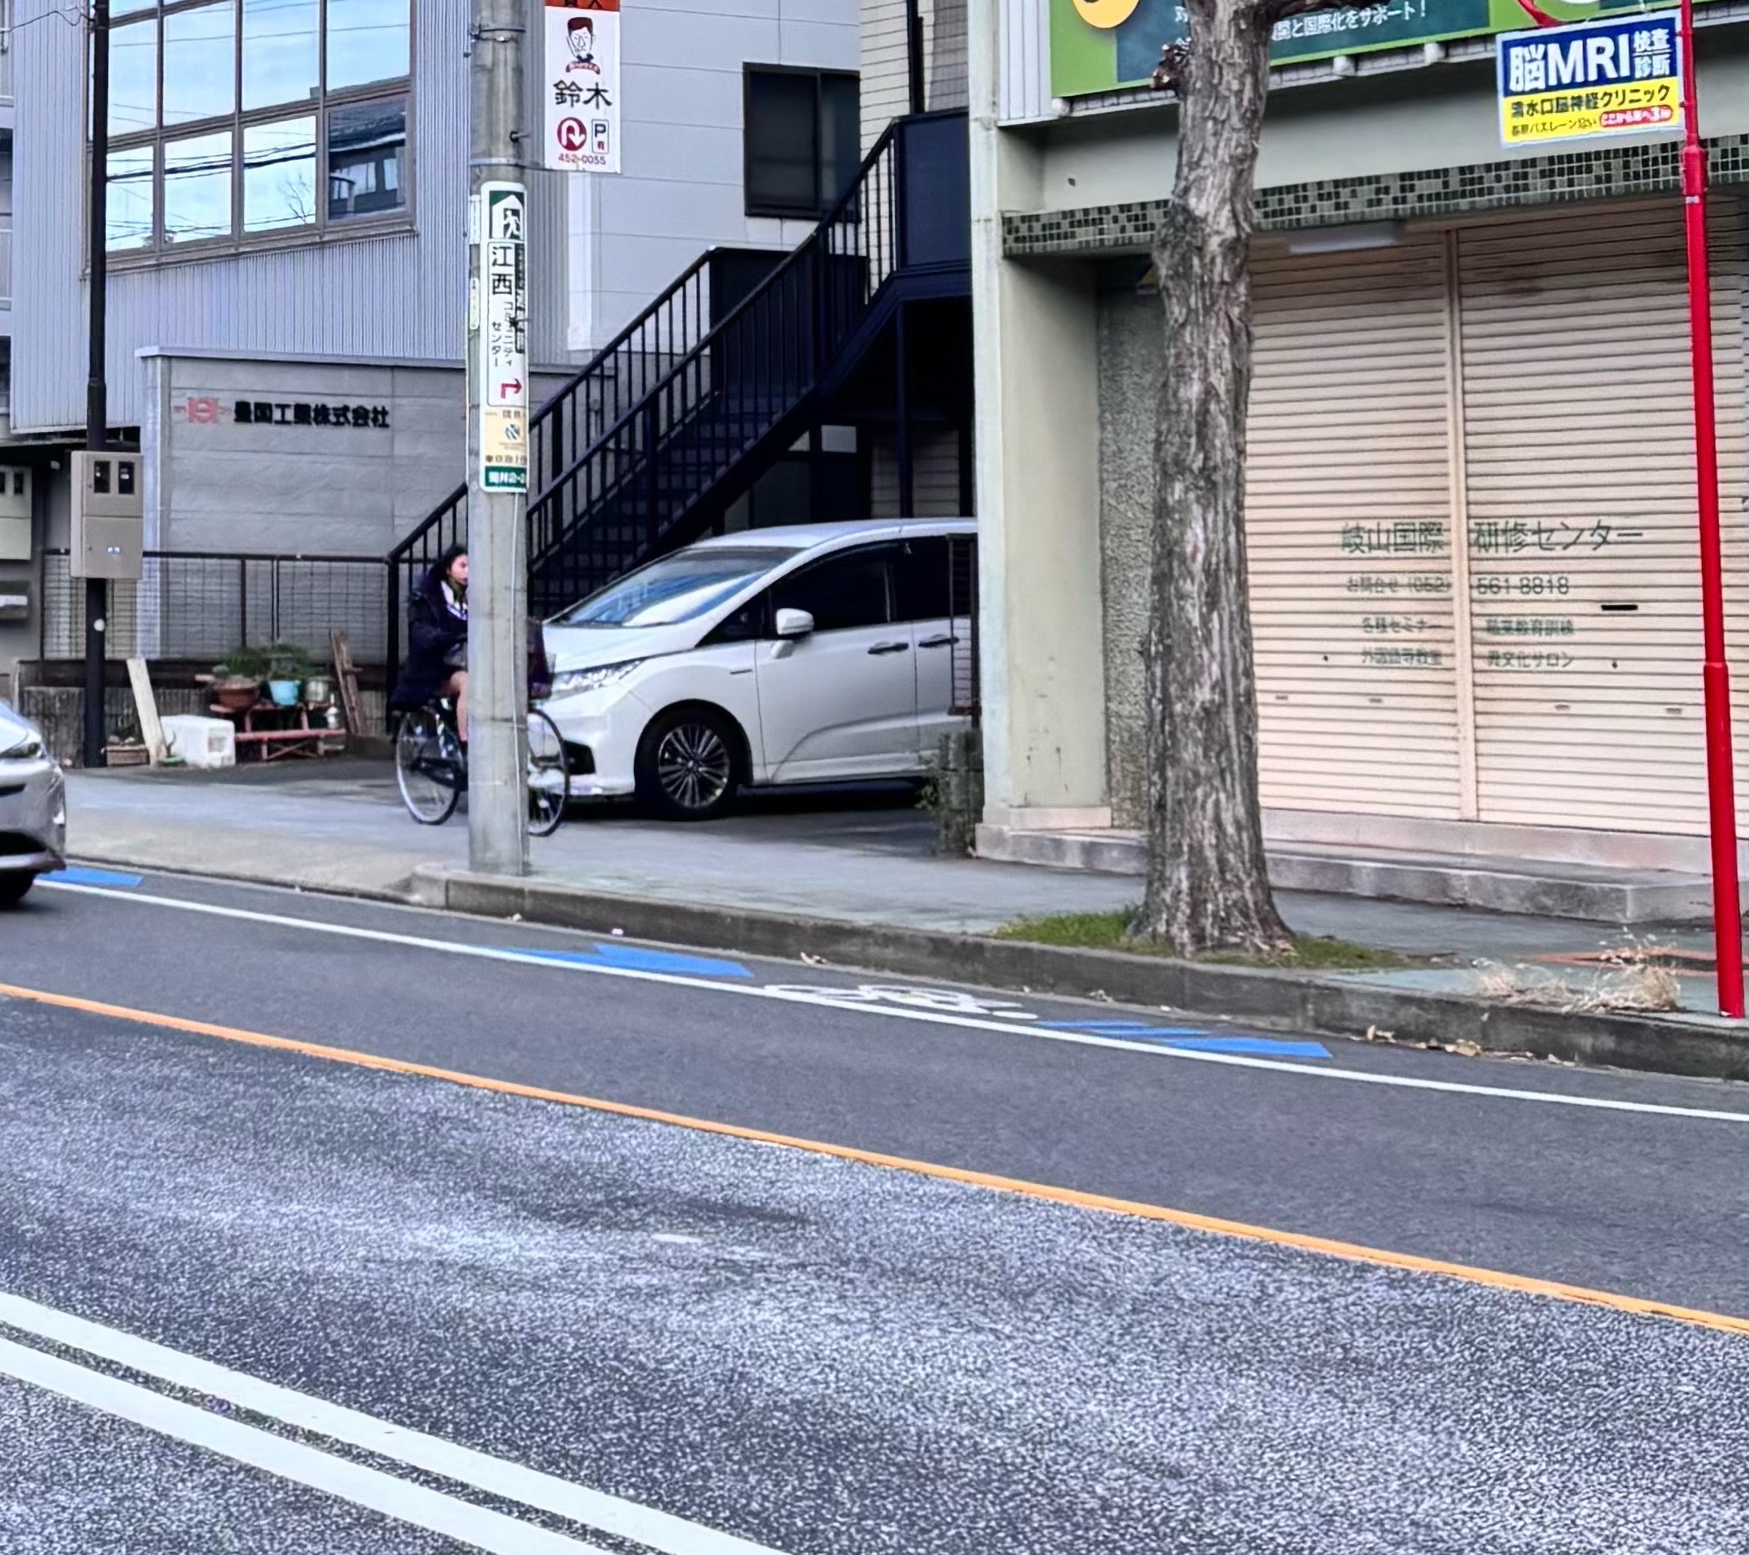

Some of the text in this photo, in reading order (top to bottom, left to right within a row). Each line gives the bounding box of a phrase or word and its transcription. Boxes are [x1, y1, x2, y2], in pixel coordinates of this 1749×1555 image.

[1633, 27, 1670, 53] 検査
[1509, 32, 1632, 92] 脳MRI
[1633, 54, 1670, 79] 診断
[553, 79, 613, 110] 鈴木
[595, 123, 606, 138] P
[491, 245, 514, 296] 江西
[491, 321, 502, 367] センター
